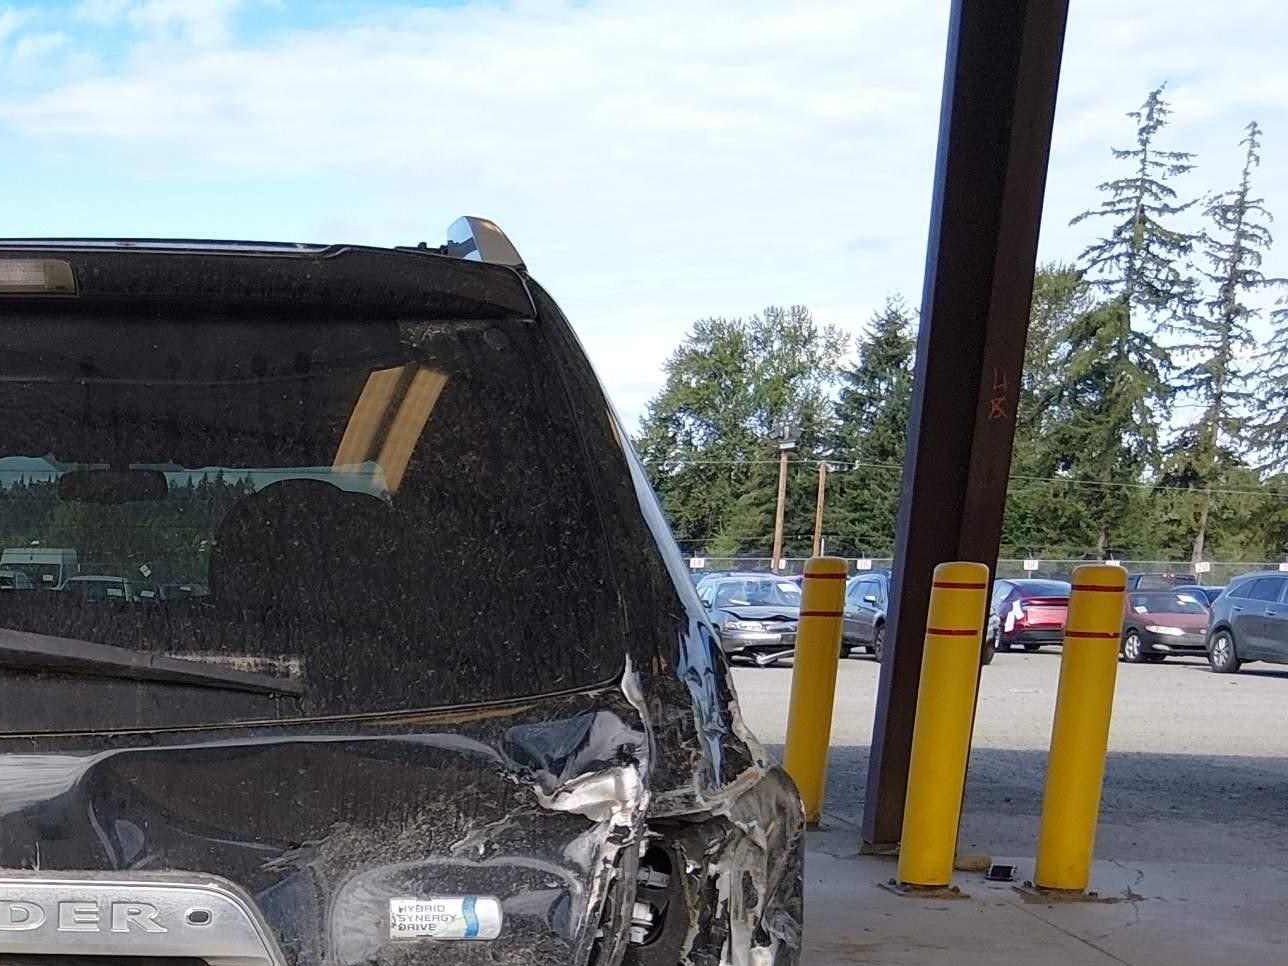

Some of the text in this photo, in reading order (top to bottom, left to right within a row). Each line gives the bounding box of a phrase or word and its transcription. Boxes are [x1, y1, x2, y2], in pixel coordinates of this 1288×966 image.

[398, 904, 446, 914] HYBRID
[398, 914, 458, 922] SYNERGY
[398, 923, 437, 932] DRIVE
